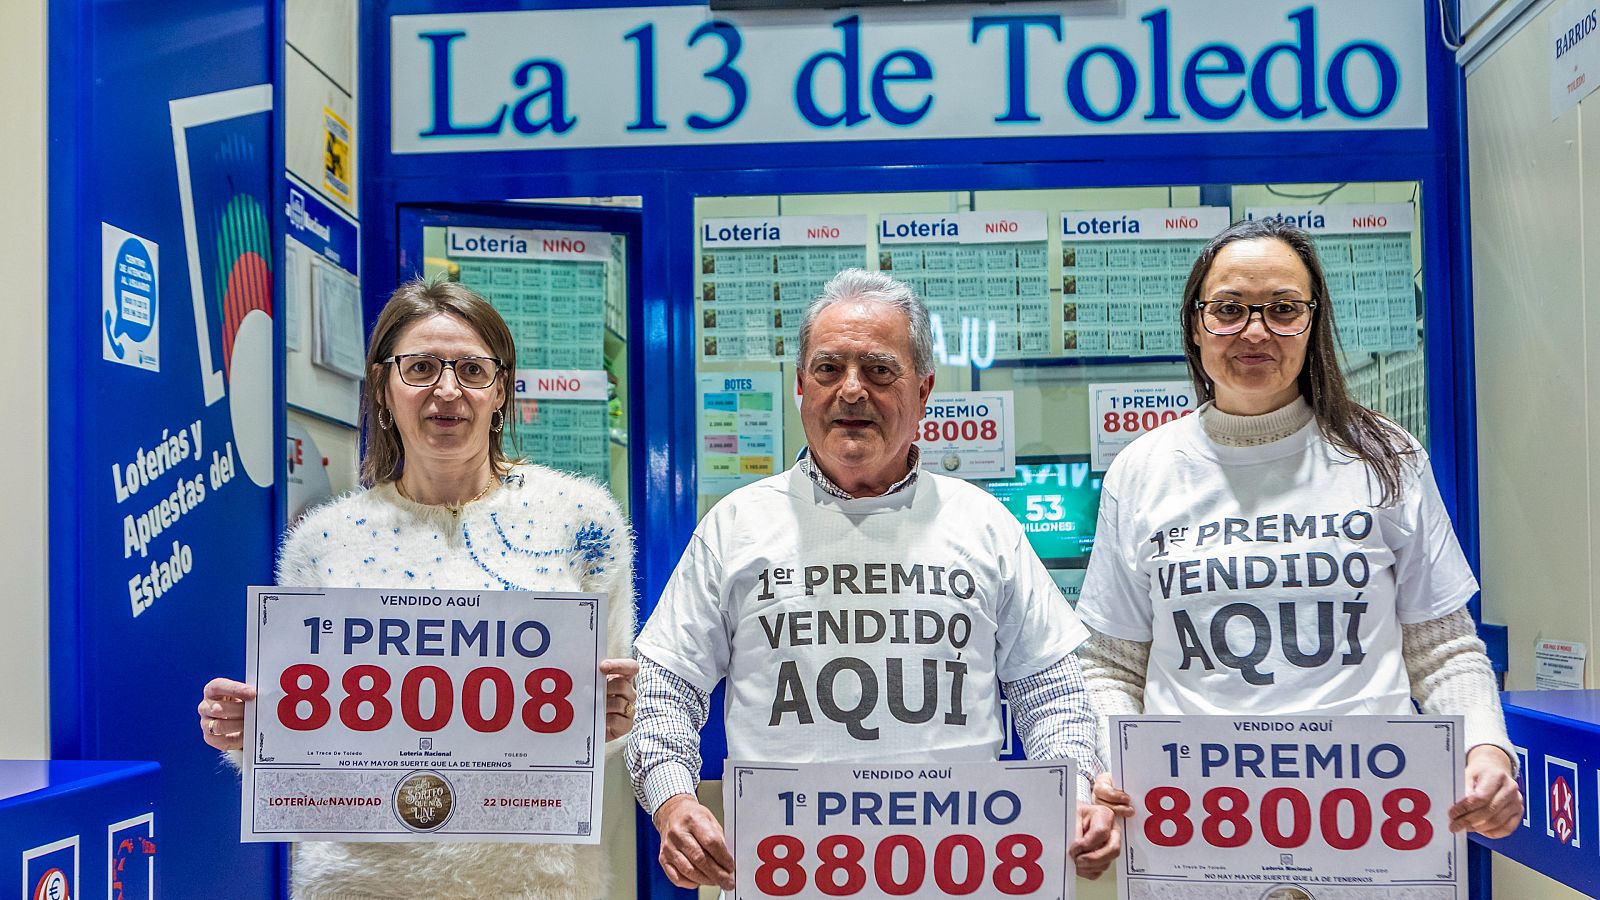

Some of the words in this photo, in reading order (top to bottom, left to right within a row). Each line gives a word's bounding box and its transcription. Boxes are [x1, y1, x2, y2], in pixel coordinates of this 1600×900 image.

[1556, 8, 1597, 59] BARRIOS
[418, 31, 577, 138] La
[623, 20, 749, 131] 13
[795, 14, 934, 129] de
[972, 5, 1399, 122] Toledo
[705, 222, 780, 242] Lotería
[807, 226, 840, 239] NIÑO
[883, 219, 959, 239] Lotería
[985, 220, 1018, 234] NIÑO
[1063, 216, 1140, 235] Lotería
[1165, 217, 1198, 229] NIÑO
[1352, 214, 1387, 228] NIÑO
[451, 233, 527, 254] Lotería
[543, 237, 586, 254] NIÑO
[538, 376, 581, 392] NIÑO
[724, 378, 752, 390] BOTES
[1123, 395, 1189, 409] PREMIO
[1104, 409, 1195, 433] 8800
[112, 428, 189, 503] Loterías
[190, 420, 202, 460] y
[123, 474, 206, 559] Apuestas
[210, 442, 235, 492] del
[1025, 494, 1065, 521] 53
[1195, 510, 1373, 547] PREMIO
[128, 541, 193, 618] Estado
[804, 563, 976, 600] PREMIO
[1158, 551, 1370, 600] VENDIDO
[380, 595, 442, 607] VENDIDO
[446, 595, 480, 608] AQUÍ
[343, 617, 551, 658] PREMIO
[758, 609, 972, 649] VENDIDO
[1172, 592, 1369, 685] AQUÍ
[277, 663, 575, 734] 88008
[768, 652, 968, 741] AQUÍ
[1233, 721, 1294, 732] VENDIDO
[1299, 720, 1333, 733] AQUÍ
[852, 769, 914, 780] VENDIDO
[918, 767, 952, 781] AQUÍ
[1201, 743, 1406, 779] PREMIO
[483, 798, 497, 807] 22
[500, 798, 562, 808] DICIEMBRE
[817, 790, 1022, 826] PREMIO
[1143, 786, 1434, 851] 88008
[754, 833, 1045, 897] 88008
